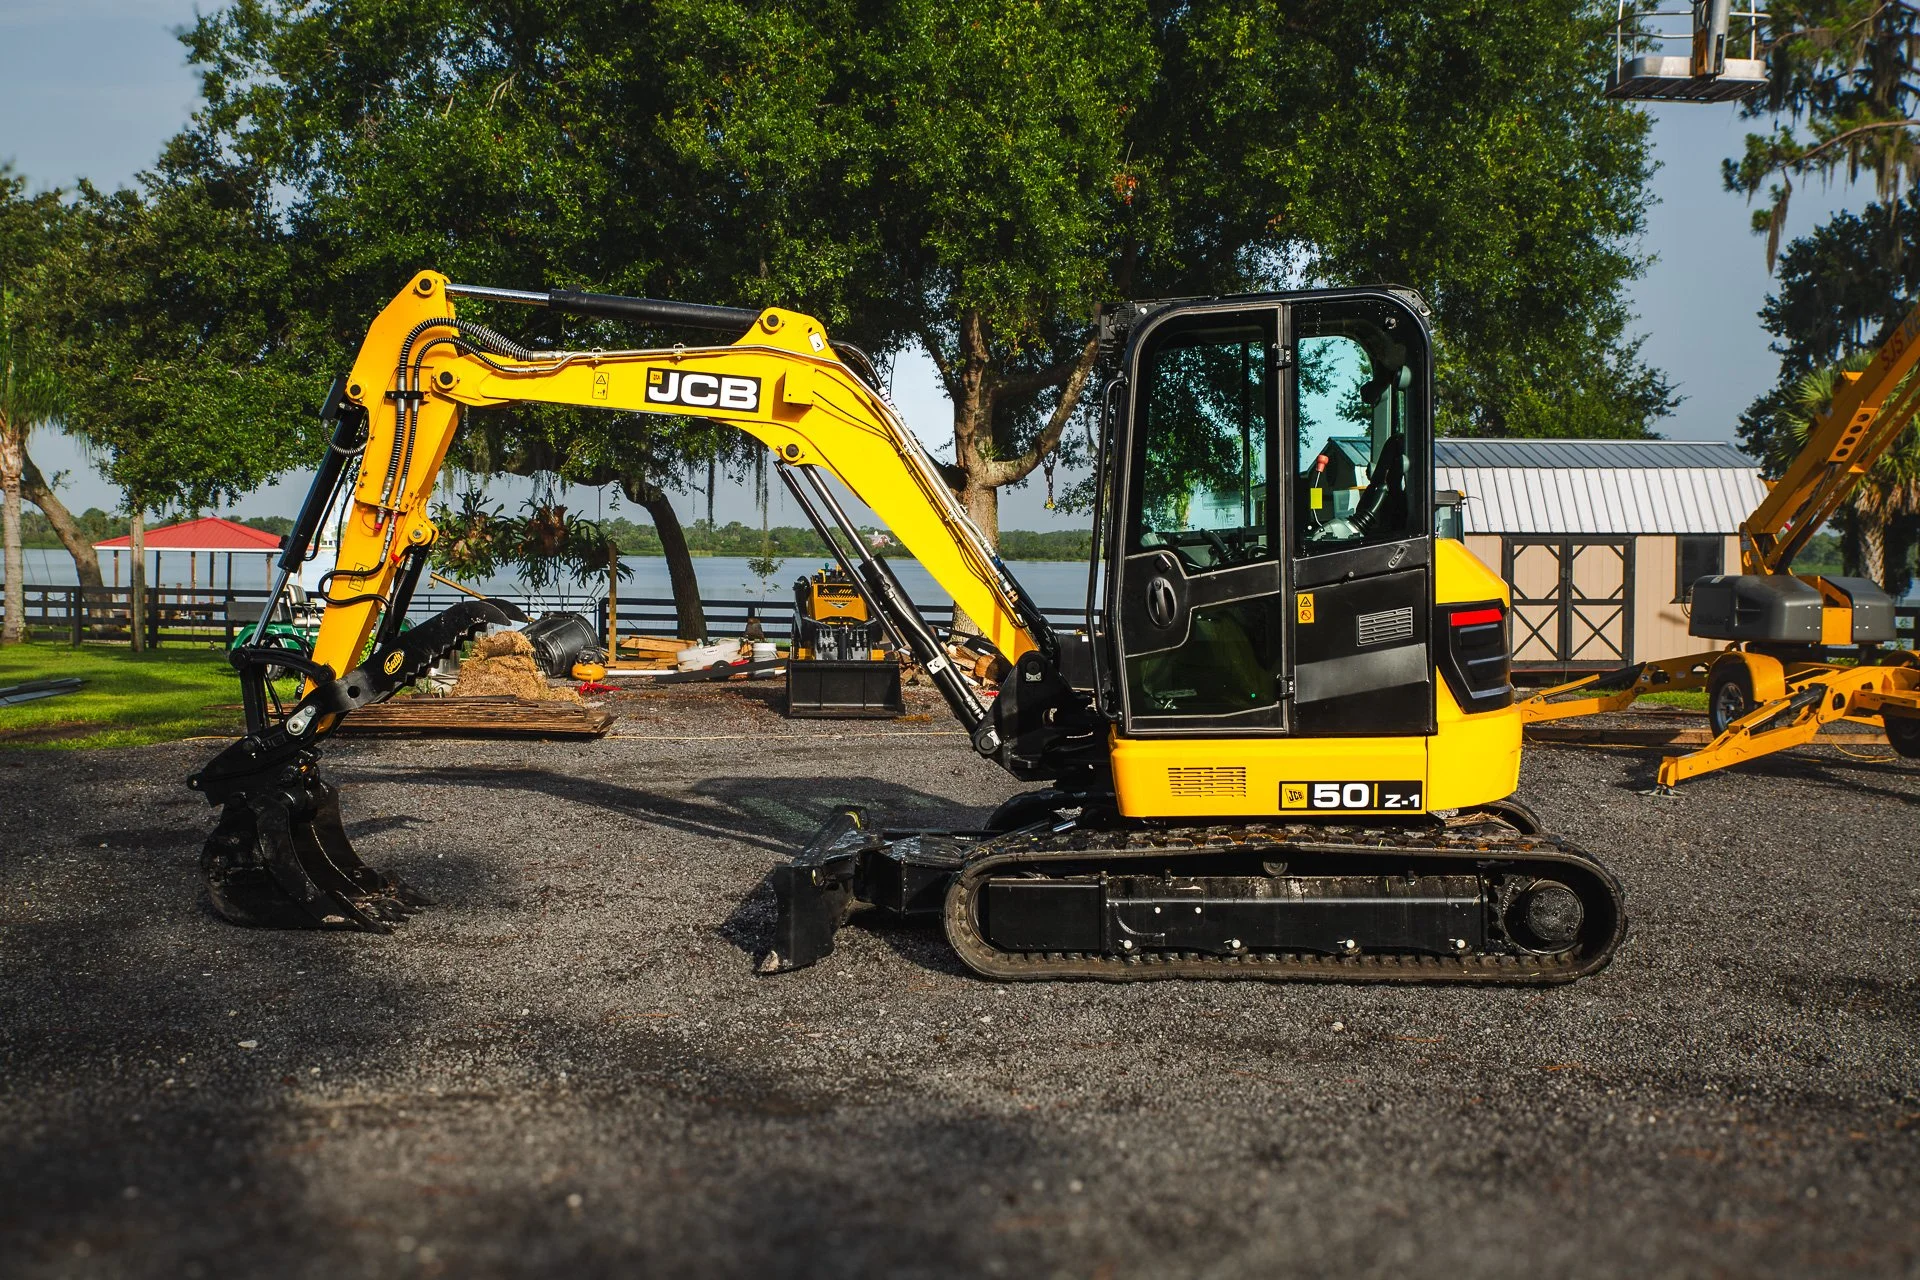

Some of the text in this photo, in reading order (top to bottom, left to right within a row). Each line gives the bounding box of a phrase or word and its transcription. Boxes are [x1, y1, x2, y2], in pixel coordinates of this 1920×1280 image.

[649, 372, 758, 410] JCB
[1287, 789, 1304, 802] JCB
[1313, 783, 1420, 808] 50 Z-1
